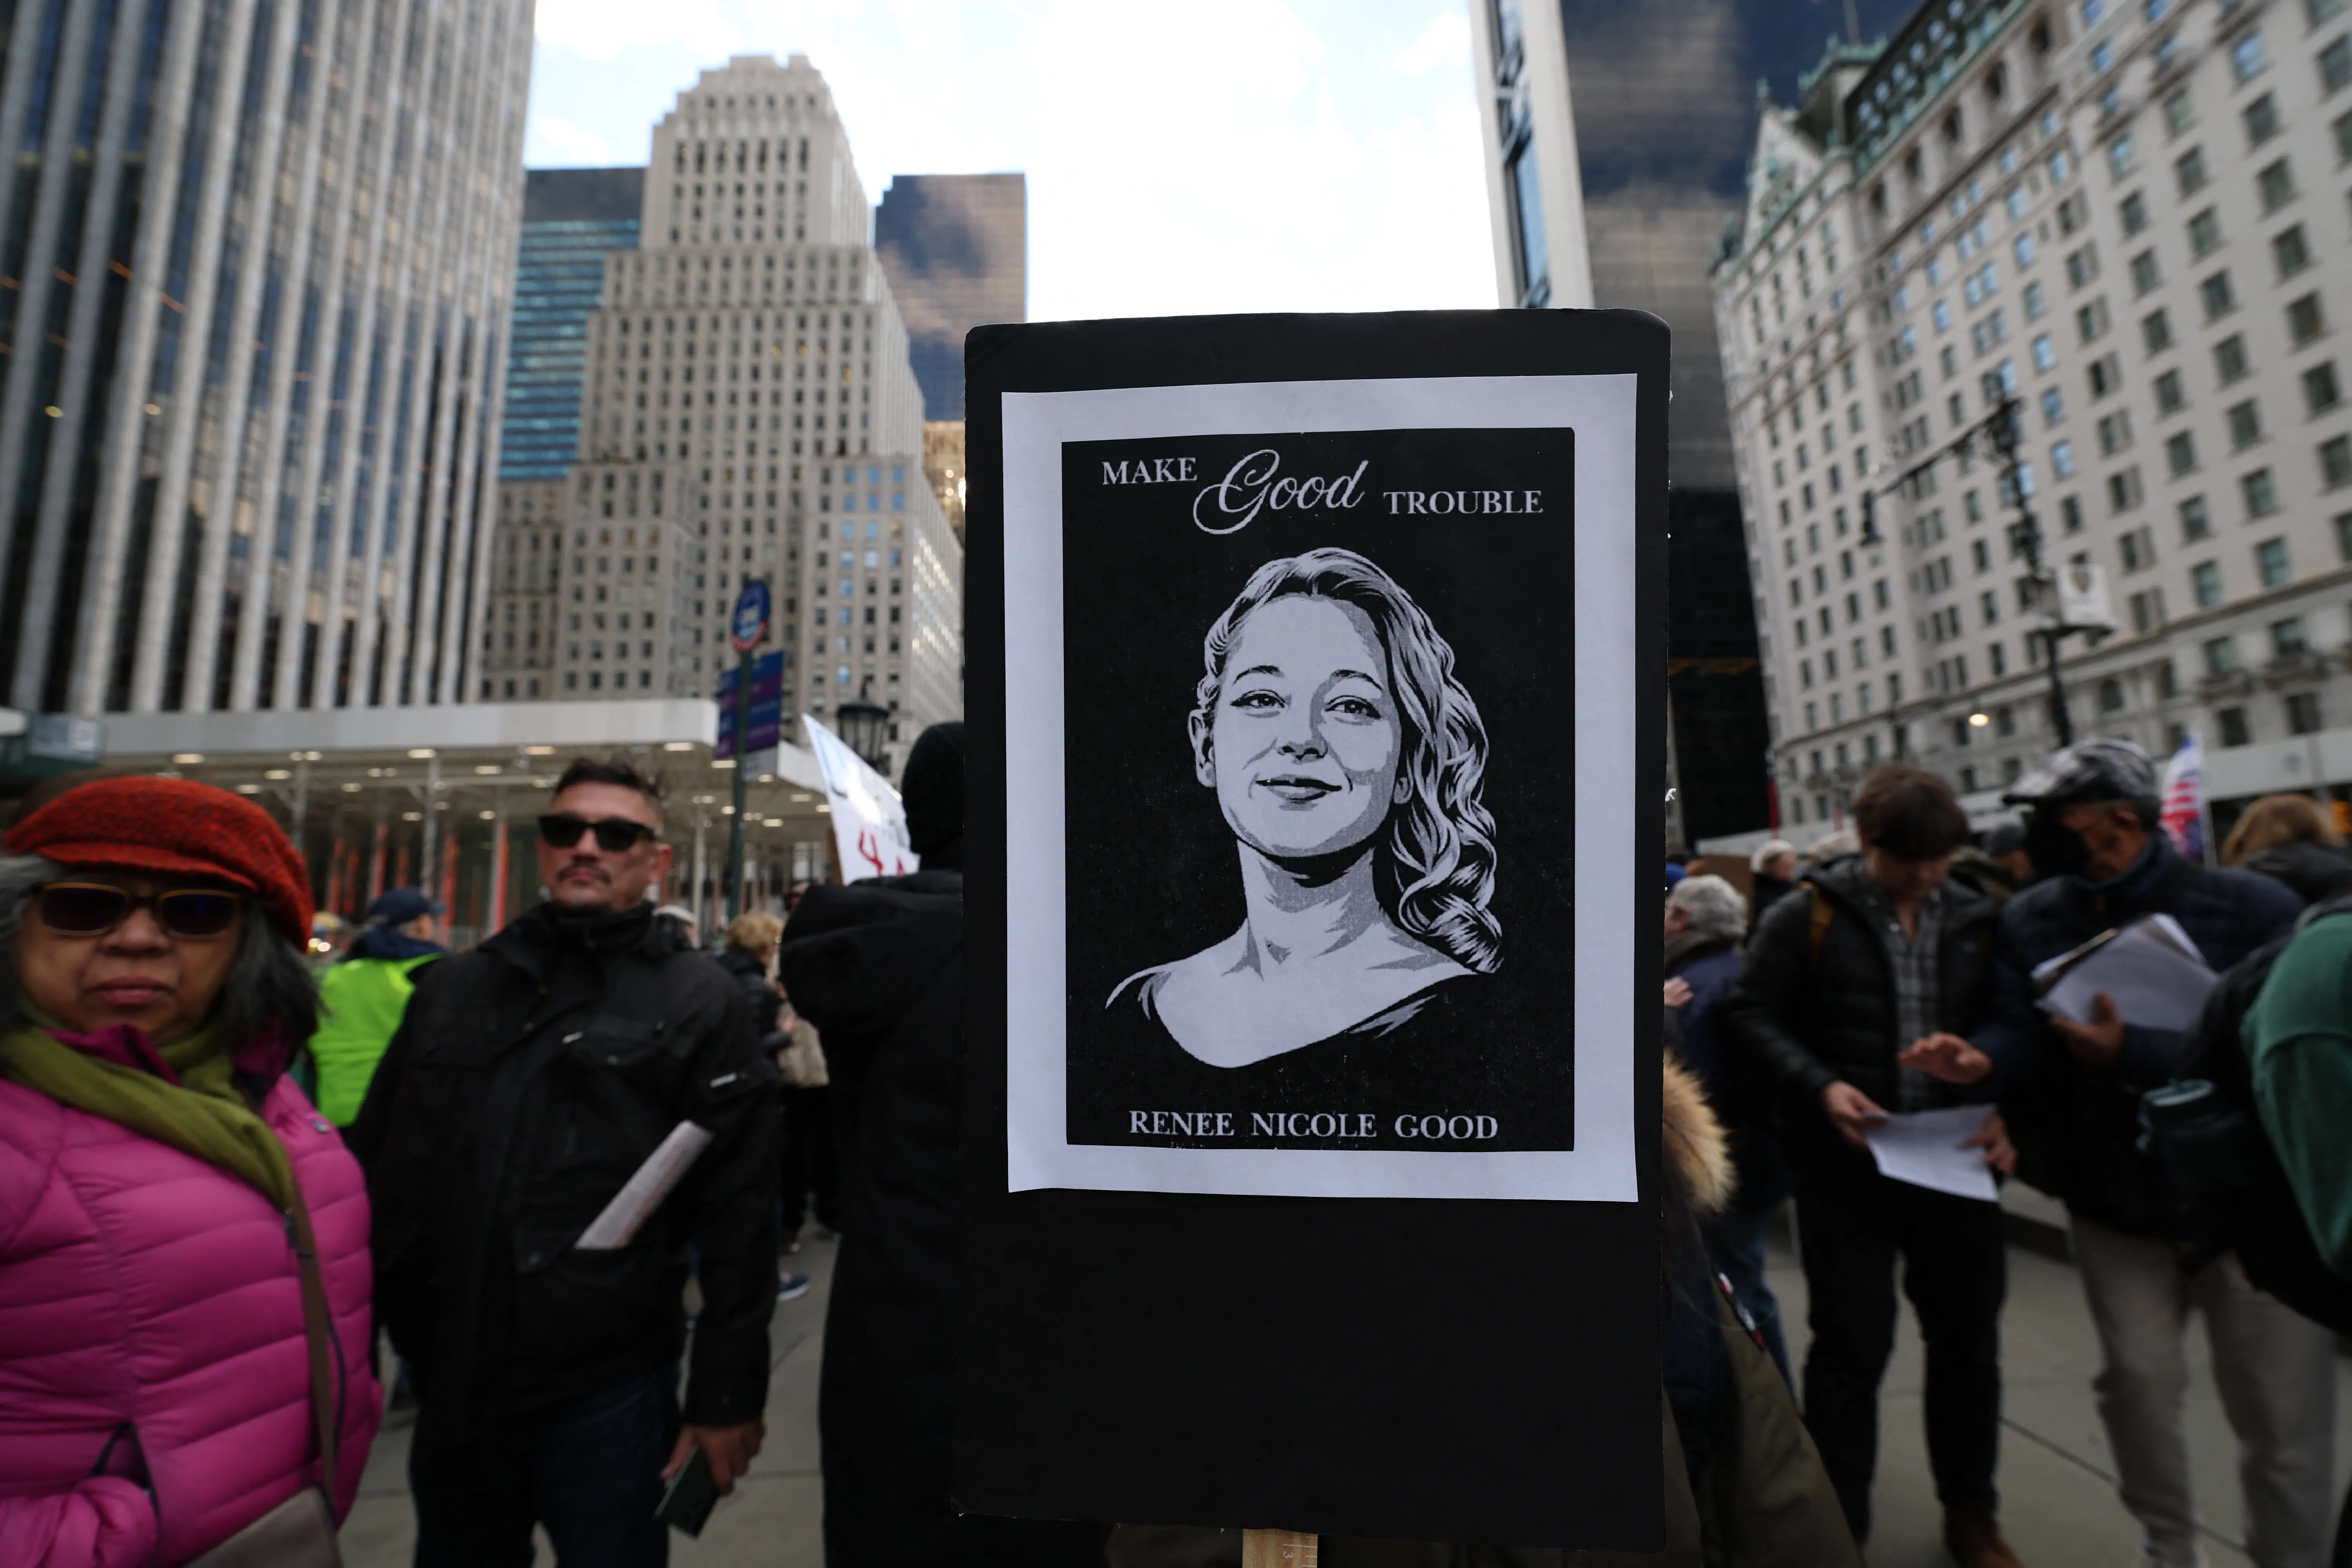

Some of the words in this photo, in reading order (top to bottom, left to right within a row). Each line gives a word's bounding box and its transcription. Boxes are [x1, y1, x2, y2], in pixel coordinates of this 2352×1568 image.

[1102, 457, 1197, 485] MAKE
[1192, 449, 1368, 535] Good
[1383, 490, 1544, 514] TROUBLE
[1129, 1111, 1235, 1136] RENEE
[1251, 1112, 1377, 1137] NICOLE
[1395, 1114, 1498, 1139] GOOD
[1283, 1550, 1293, 1559] 3
